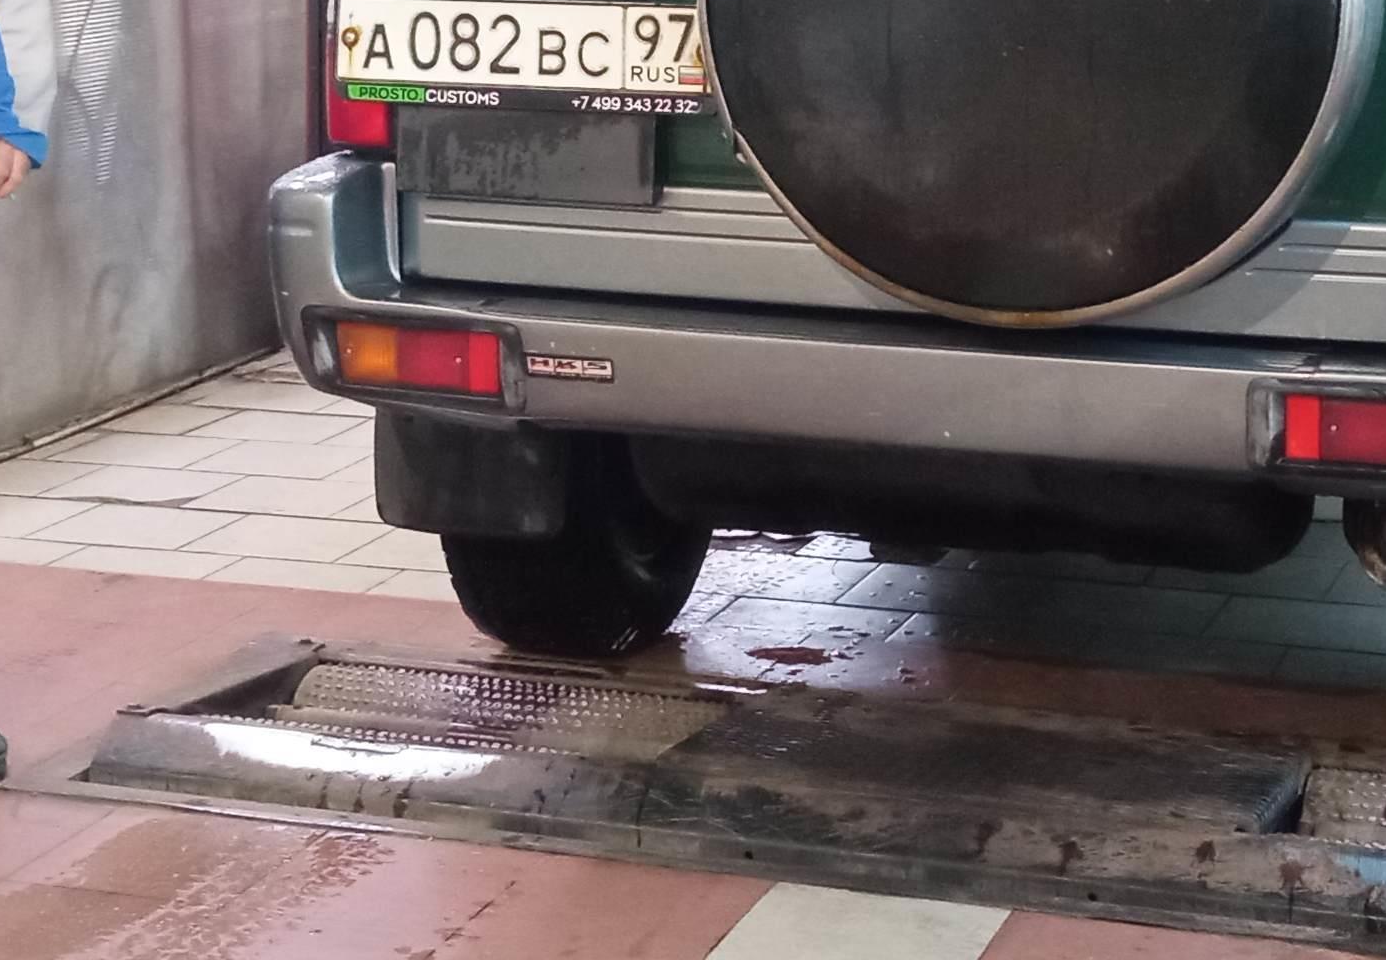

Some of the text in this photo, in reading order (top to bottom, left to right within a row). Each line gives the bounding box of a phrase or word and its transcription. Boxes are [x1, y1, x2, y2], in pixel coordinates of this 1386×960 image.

[634, 13, 696, 64] 97
[631, 65, 676, 84] RUS
[425, 88, 500, 105] CUSTOMS
[571, 95, 590, 110] +7
[591, 96, 622, 111] 499
[624, 97, 652, 112] 343
[654, 98, 672, 113] 22
[529, 358, 608, 371] HKS
